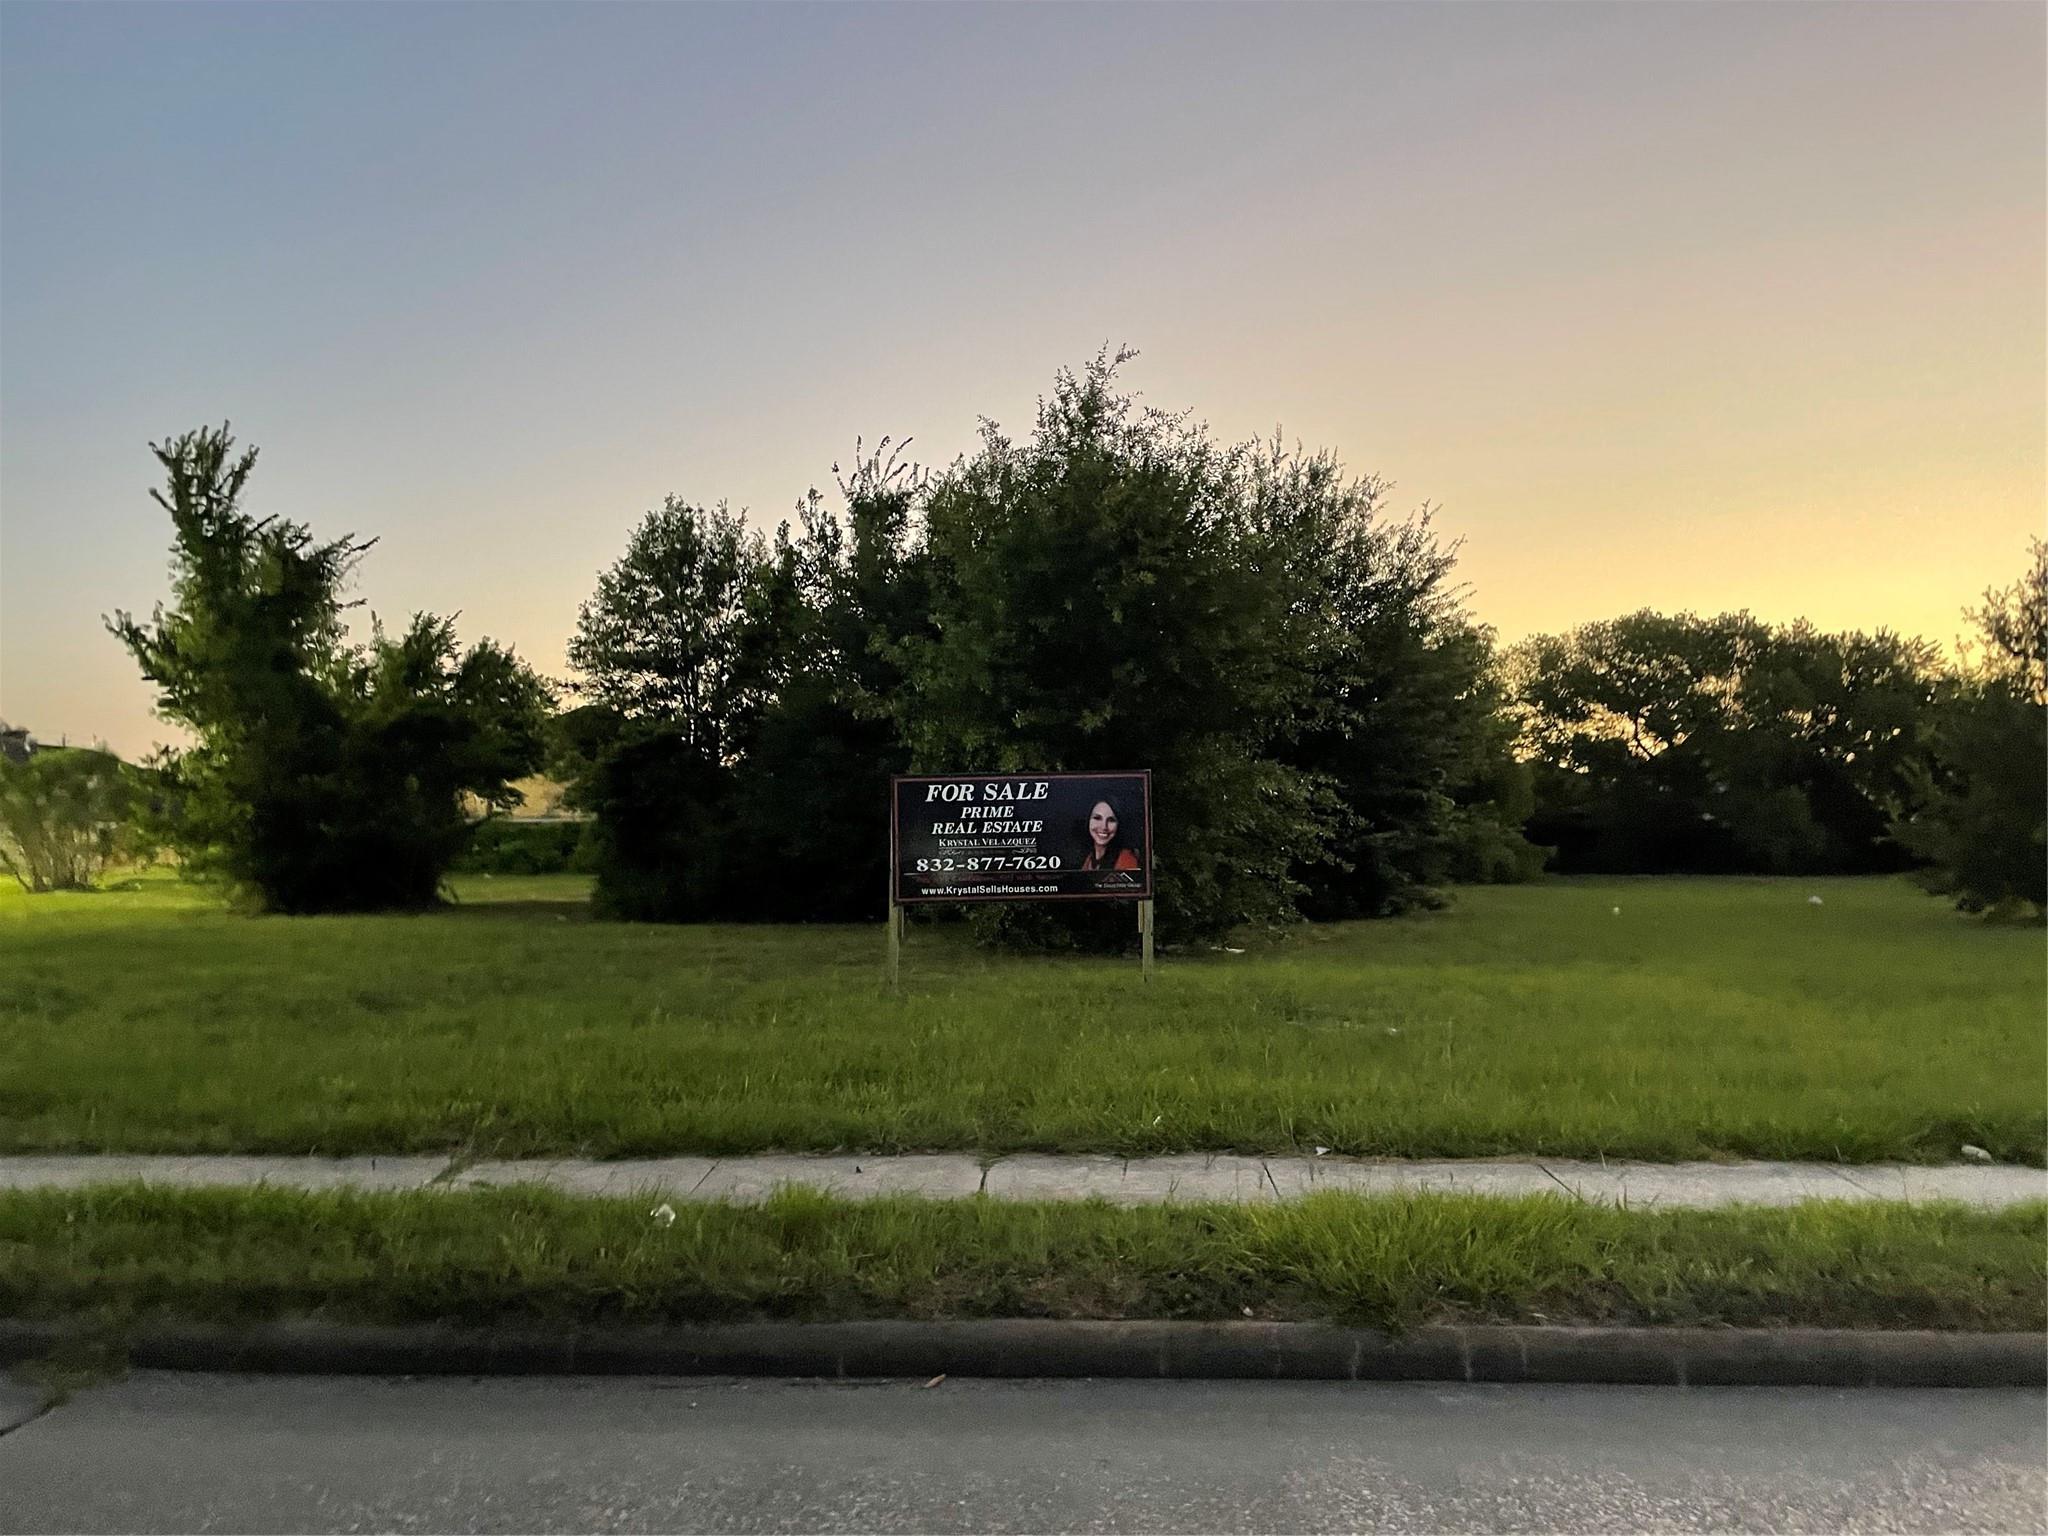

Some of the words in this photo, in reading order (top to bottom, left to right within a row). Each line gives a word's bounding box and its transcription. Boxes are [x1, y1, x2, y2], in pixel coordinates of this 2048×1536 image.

[925, 784, 975, 802] FOR
[983, 782, 1049, 801] SALE
[960, 805, 1014, 819] PRIME
[931, 822, 977, 835] REAL
[982, 820, 1043, 834] ESTATE
[916, 855, 1061, 872] 832-877-7620
[921, 884, 1058, 896] www.KrystalSellsHouses.com
